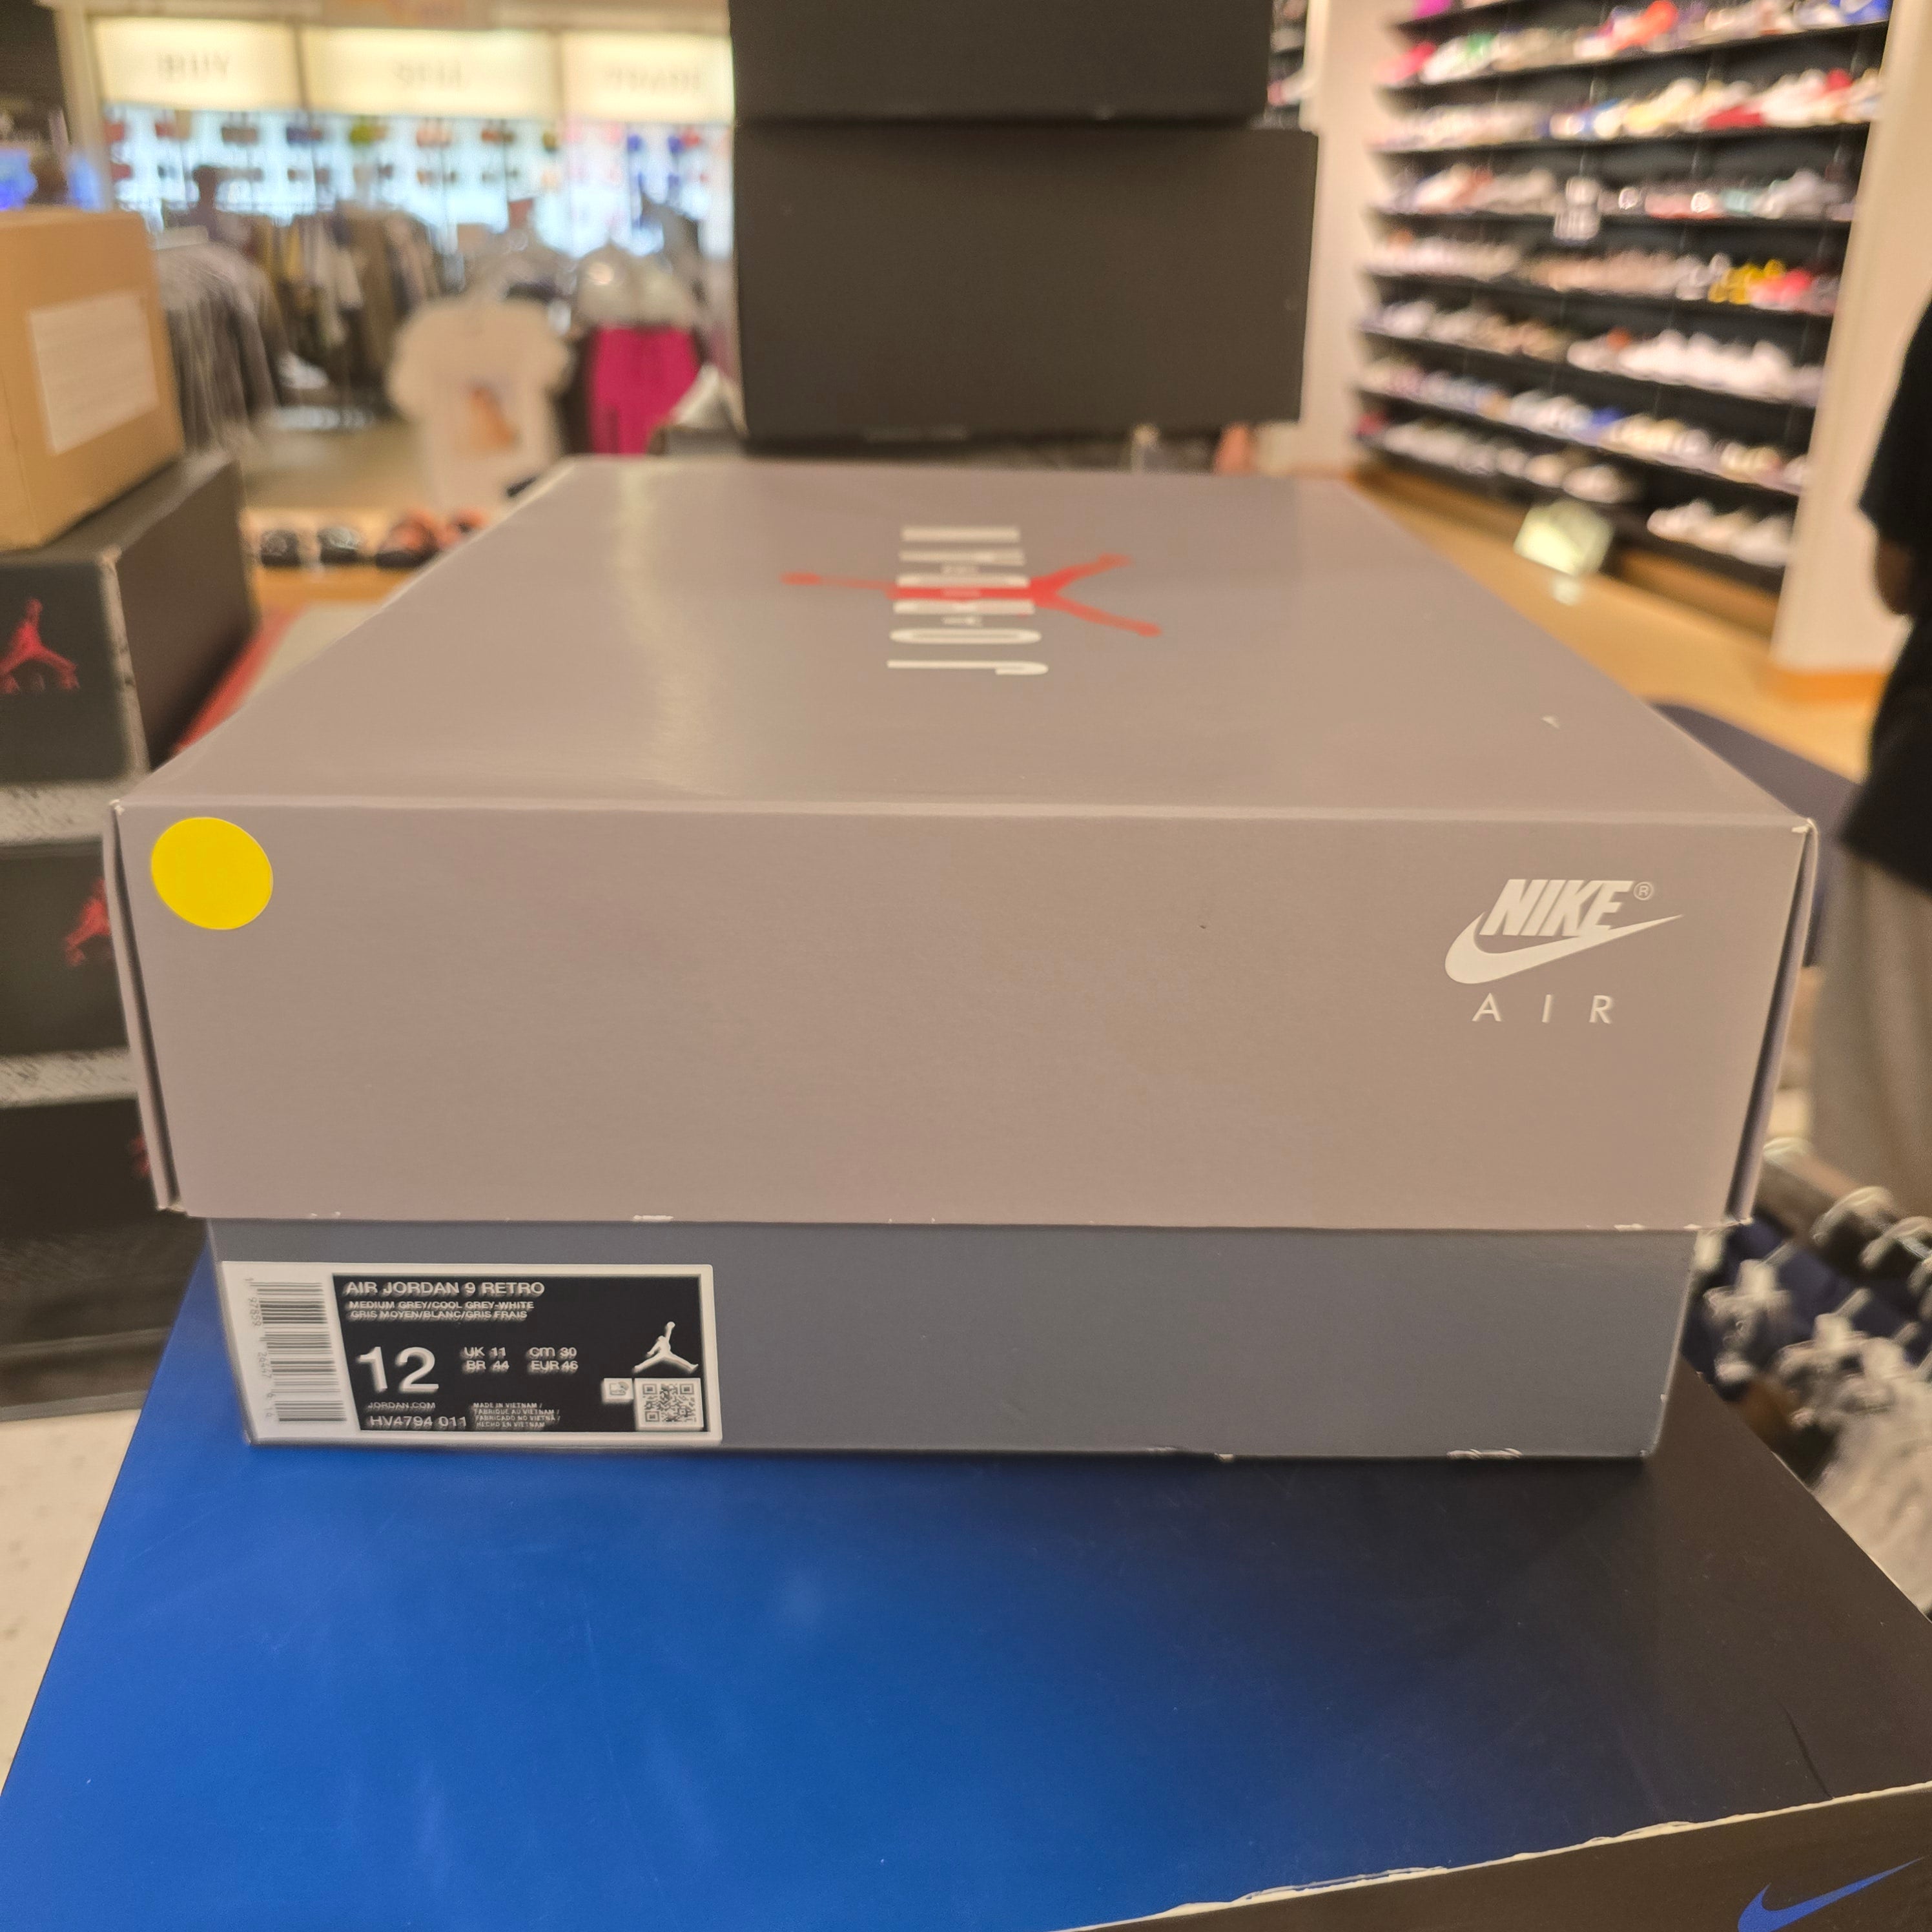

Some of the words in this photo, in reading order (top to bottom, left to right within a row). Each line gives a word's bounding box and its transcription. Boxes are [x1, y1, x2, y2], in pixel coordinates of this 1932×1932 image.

[1479, 879, 1634, 936] NIKE
[1472, 992, 1612, 1023] AIR
[345, 1282, 378, 1295] AIR
[382, 1282, 460, 1295] JORDAN
[464, 1282, 476, 1295] 9
[482, 1282, 545, 1295] RETRO
[349, 1301, 395, 1310] MEDIUM
[398, 1301, 462, 1310] GREY/COOL
[466, 1301, 535, 1310] GREY-WHITE
[351, 1311, 377, 1319] GRIS
[381, 1311, 492, 1319] MOYEN/BLANC/GRIS
[495, 1311, 528, 1319] FRAIS
[464, 1346, 485, 1357] UK
[490, 1346, 506, 1357] 11
[560, 1347, 577, 1357] 30
[359, 1346, 439, 1392] 12
[466, 1361, 486, 1370] BR
[492, 1361, 510, 1370] 44
[531, 1361, 559, 1370] EUR
[560, 1361, 579, 1370] 46
[369, 1415, 434, 1427] HV4794
[437, 1416, 467, 1427] 011
